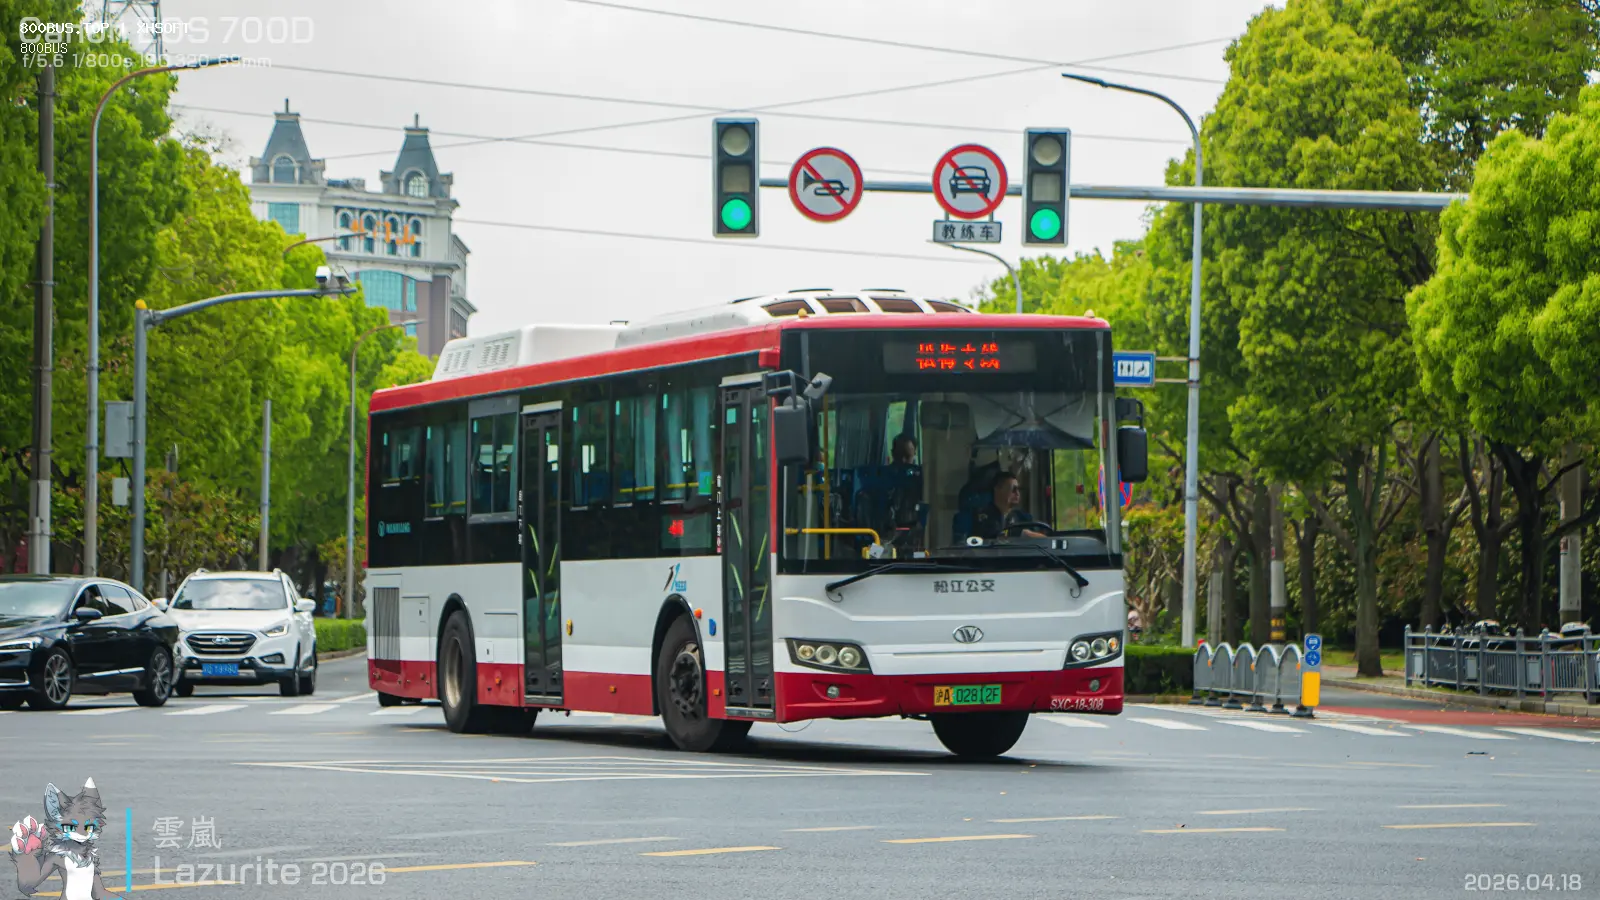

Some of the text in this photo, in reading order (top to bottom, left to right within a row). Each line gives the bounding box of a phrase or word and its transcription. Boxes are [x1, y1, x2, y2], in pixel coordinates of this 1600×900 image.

[942, 224, 994, 240] 教练车
[933, 579, 996, 594] 松江公交
[1050, 698, 1105, 711] SXC-18-308
